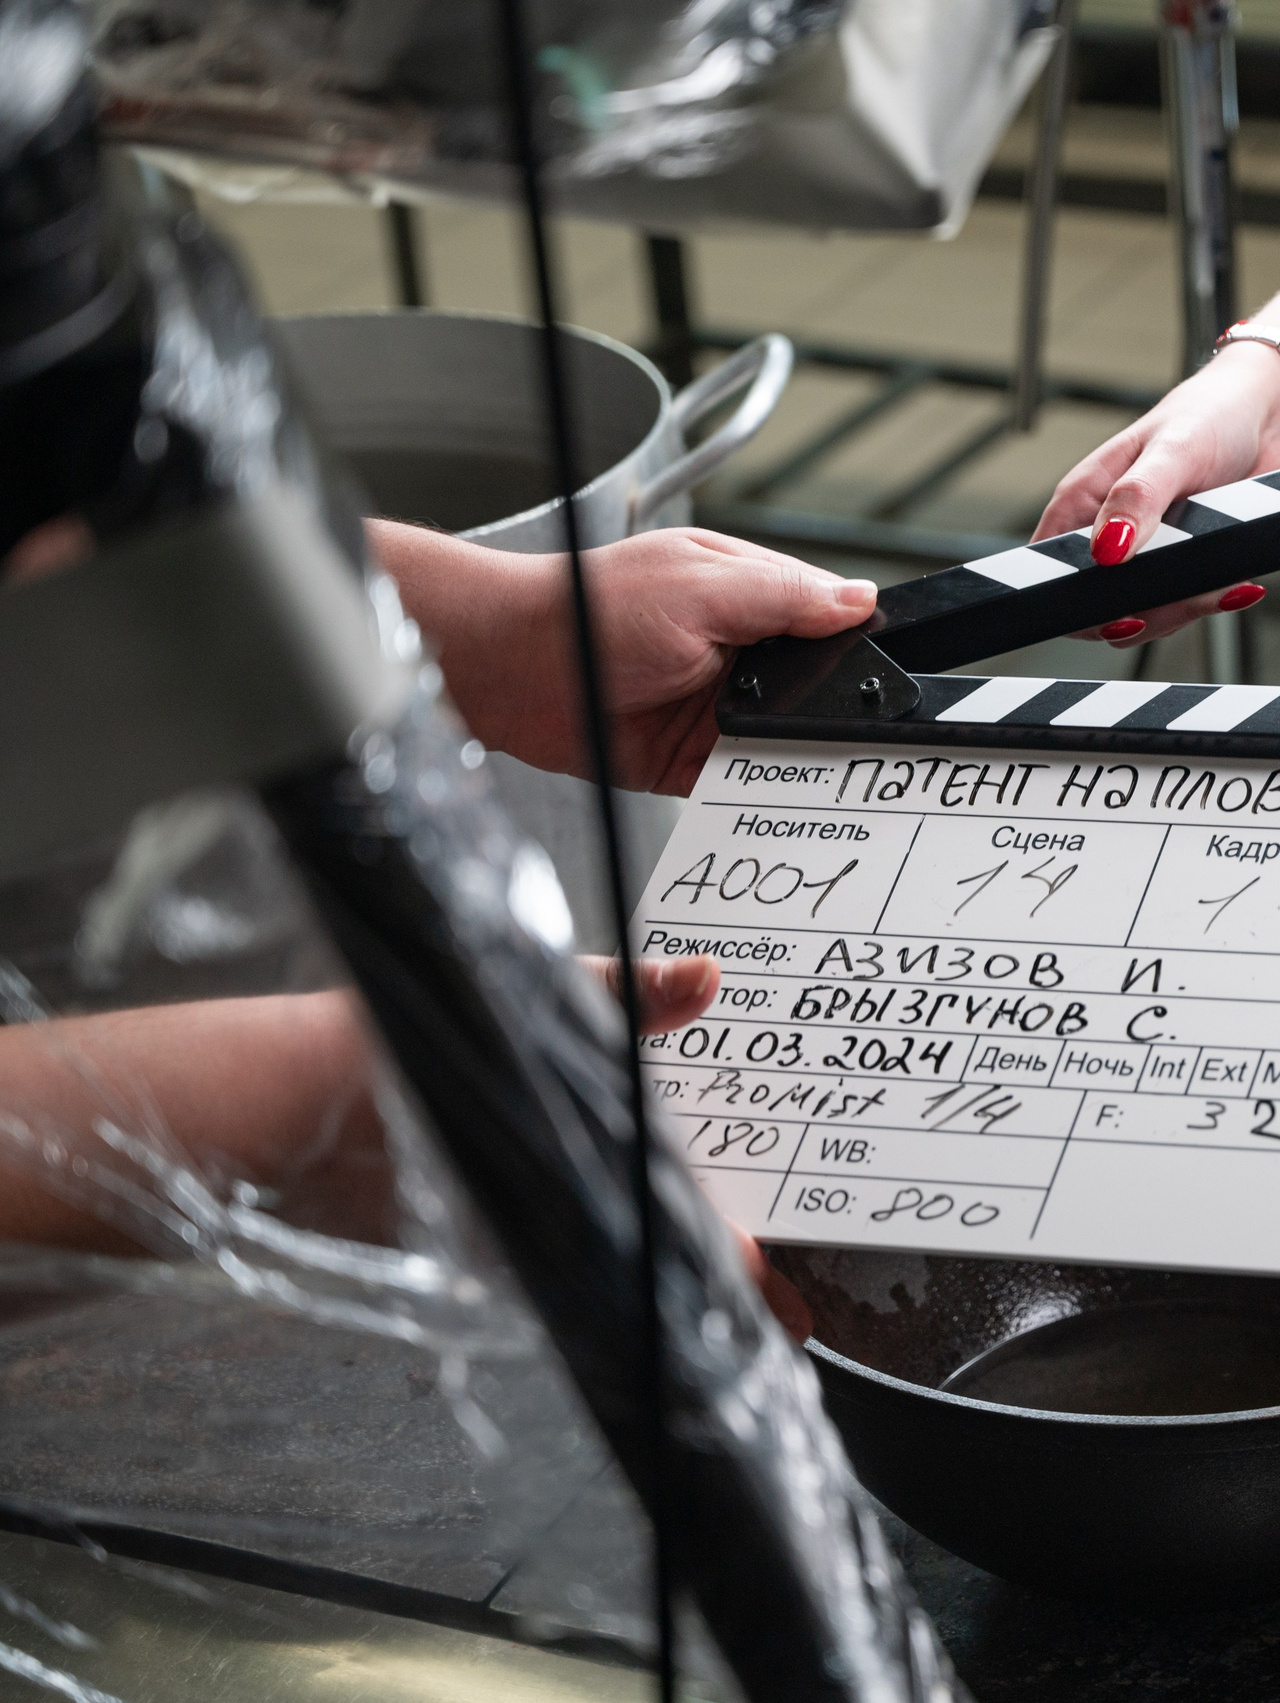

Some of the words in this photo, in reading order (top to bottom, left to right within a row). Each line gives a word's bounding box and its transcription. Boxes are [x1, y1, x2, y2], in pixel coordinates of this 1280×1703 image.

[724, 758, 835, 786] Проект:
[731, 813, 871, 842] Носитель
[990, 825, 1087, 852] Сцена
[641, 930, 797, 966] Режиссёр:
[814, 937, 1065, 988] АЗИЗОВ
[1121, 957, 1187, 994] И.
[719, 985, 778, 1009] тор:
[790, 984, 1089, 1036] БРЫЗГУНОВ
[1126, 1005, 1177, 1042] С.
[678, 1027, 953, 1075] 01.03.2024
[974, 1046, 1048, 1073] День
[1063, 1051, 1134, 1077] Ночь
[1149, 1055, 1187, 1080] Int
[1200, 1060, 1247, 1084] Ext
[1096, 1104, 1125, 1128] F:
[820, 1138, 876, 1164] WB:
[795, 1187, 856, 1213] ISO:
[871, 1187, 1001, 1226] 800
